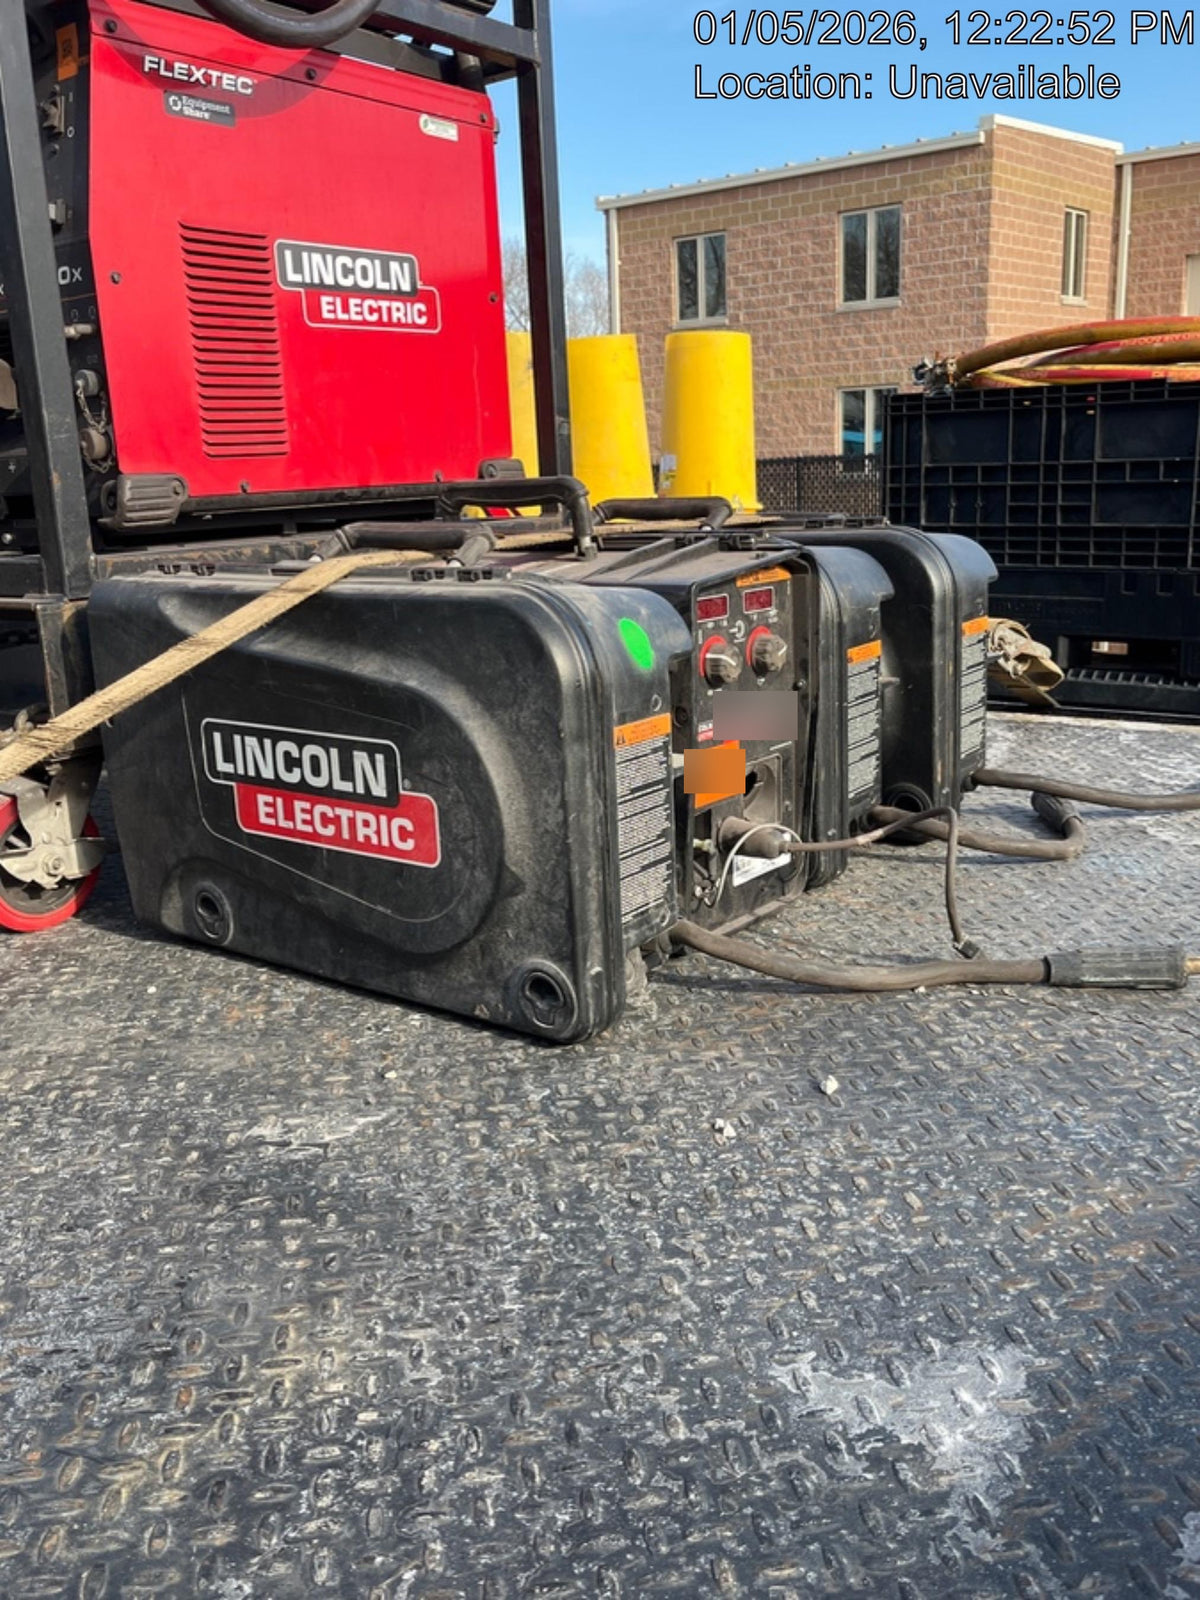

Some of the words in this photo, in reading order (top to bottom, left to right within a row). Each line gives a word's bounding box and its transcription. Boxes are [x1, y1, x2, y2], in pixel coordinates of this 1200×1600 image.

[143, 54, 255, 95] FLEXTEC
[182, 95, 231, 114] Equipment
[182, 106, 211, 120] Share
[284, 249, 411, 292] LINCOLN
[320, 295, 427, 325] ELECTRIC
[212, 731, 388, 798] LINCOLN
[256, 793, 415, 851] ELECTRIC
